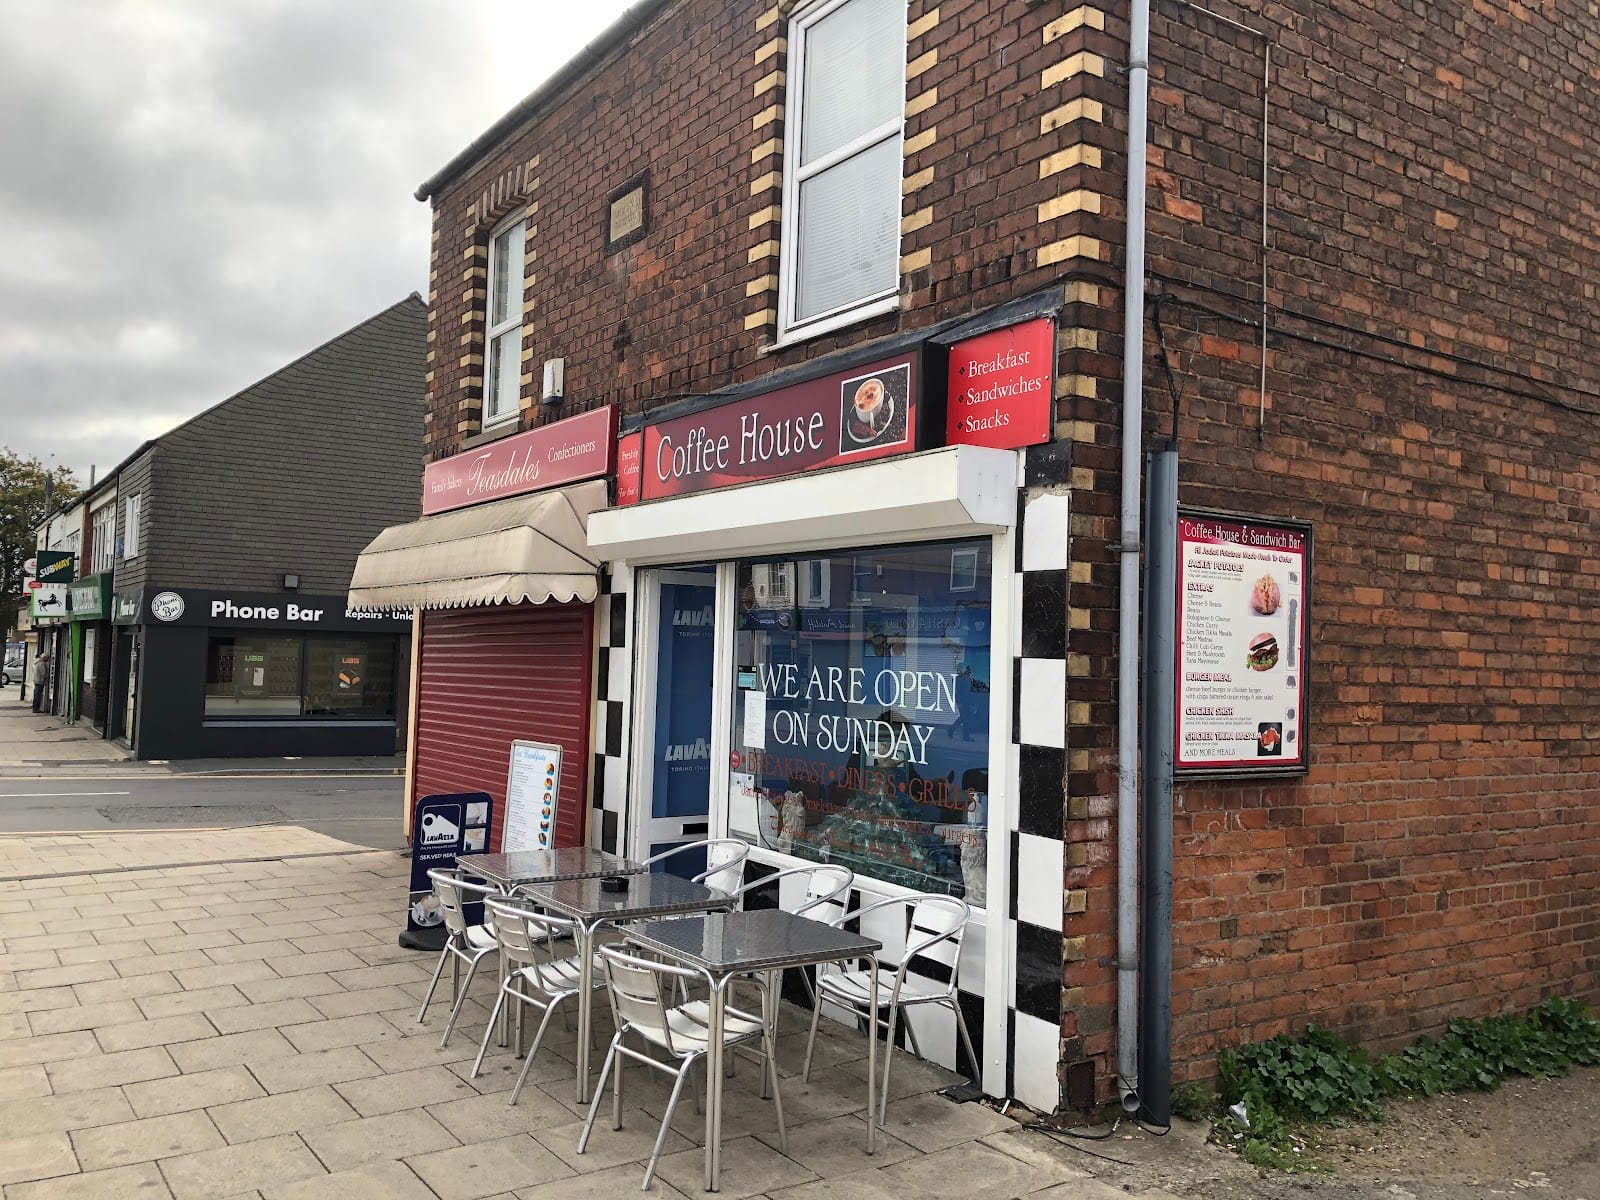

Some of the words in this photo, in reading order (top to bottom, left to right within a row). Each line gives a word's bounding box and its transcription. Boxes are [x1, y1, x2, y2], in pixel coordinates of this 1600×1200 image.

[967, 350, 1030, 378] Breakfast
[966, 376, 1042, 405] Sandwiches
[965, 413, 1010, 433] Snacks
[656, 435, 730, 483] Coffee
[738, 410, 825, 466] House
[466, 445, 540, 497] Teasdales
[547, 440, 596, 463] Confectioners
[1184, 522, 1213, 539] Coffee
[1215, 525, 1240, 542] House
[1241, 528, 1249, 543] &
[1250, 530, 1287, 547] Sandwich
[1288, 534, 1300, 550] Bar
[39, 556, 72, 579] SUBWAY
[1187, 559, 1212, 570] JACKET
[1213, 560, 1245, 572] POTATOES
[1187, 582, 1214, 592] EXTRAS
[154, 596, 178, 612] Phone
[162, 606, 178, 617] Bar
[211, 599, 280, 619] Phone
[286, 603, 324, 621] Bar
[345, 609, 383, 620] Repairs
[392, 611, 414, 621] Unlo
[672, 604, 715, 626] LAVA
[1185, 672, 1213, 682] BURGER
[1213, 672, 1232, 682] MEAL
[759, 662, 800, 699] WE
[804, 665, 866, 705] ARE
[874, 669, 959, 714] OPEN
[1185, 706, 1214, 716] CHICKEN
[1215, 706, 1234, 716] SHISH
[772, 709, 811, 747] ON
[815, 713, 935, 766] SUNDAY
[1185, 731, 1214, 741] CHICKEN
[663, 737, 711, 762] LAVA
[1184, 749, 1198, 757] AND
[1199, 748, 1216, 756] MORE
[1217, 748, 1236, 756] MEALS
[748, 752, 828, 786] BREAKFAST
[837, 767, 897, 797] DINERS
[908, 777, 977, 814] GRILLS
[427, 833, 454, 842] LAVAZZA
[419, 853, 442, 861] SERVED
